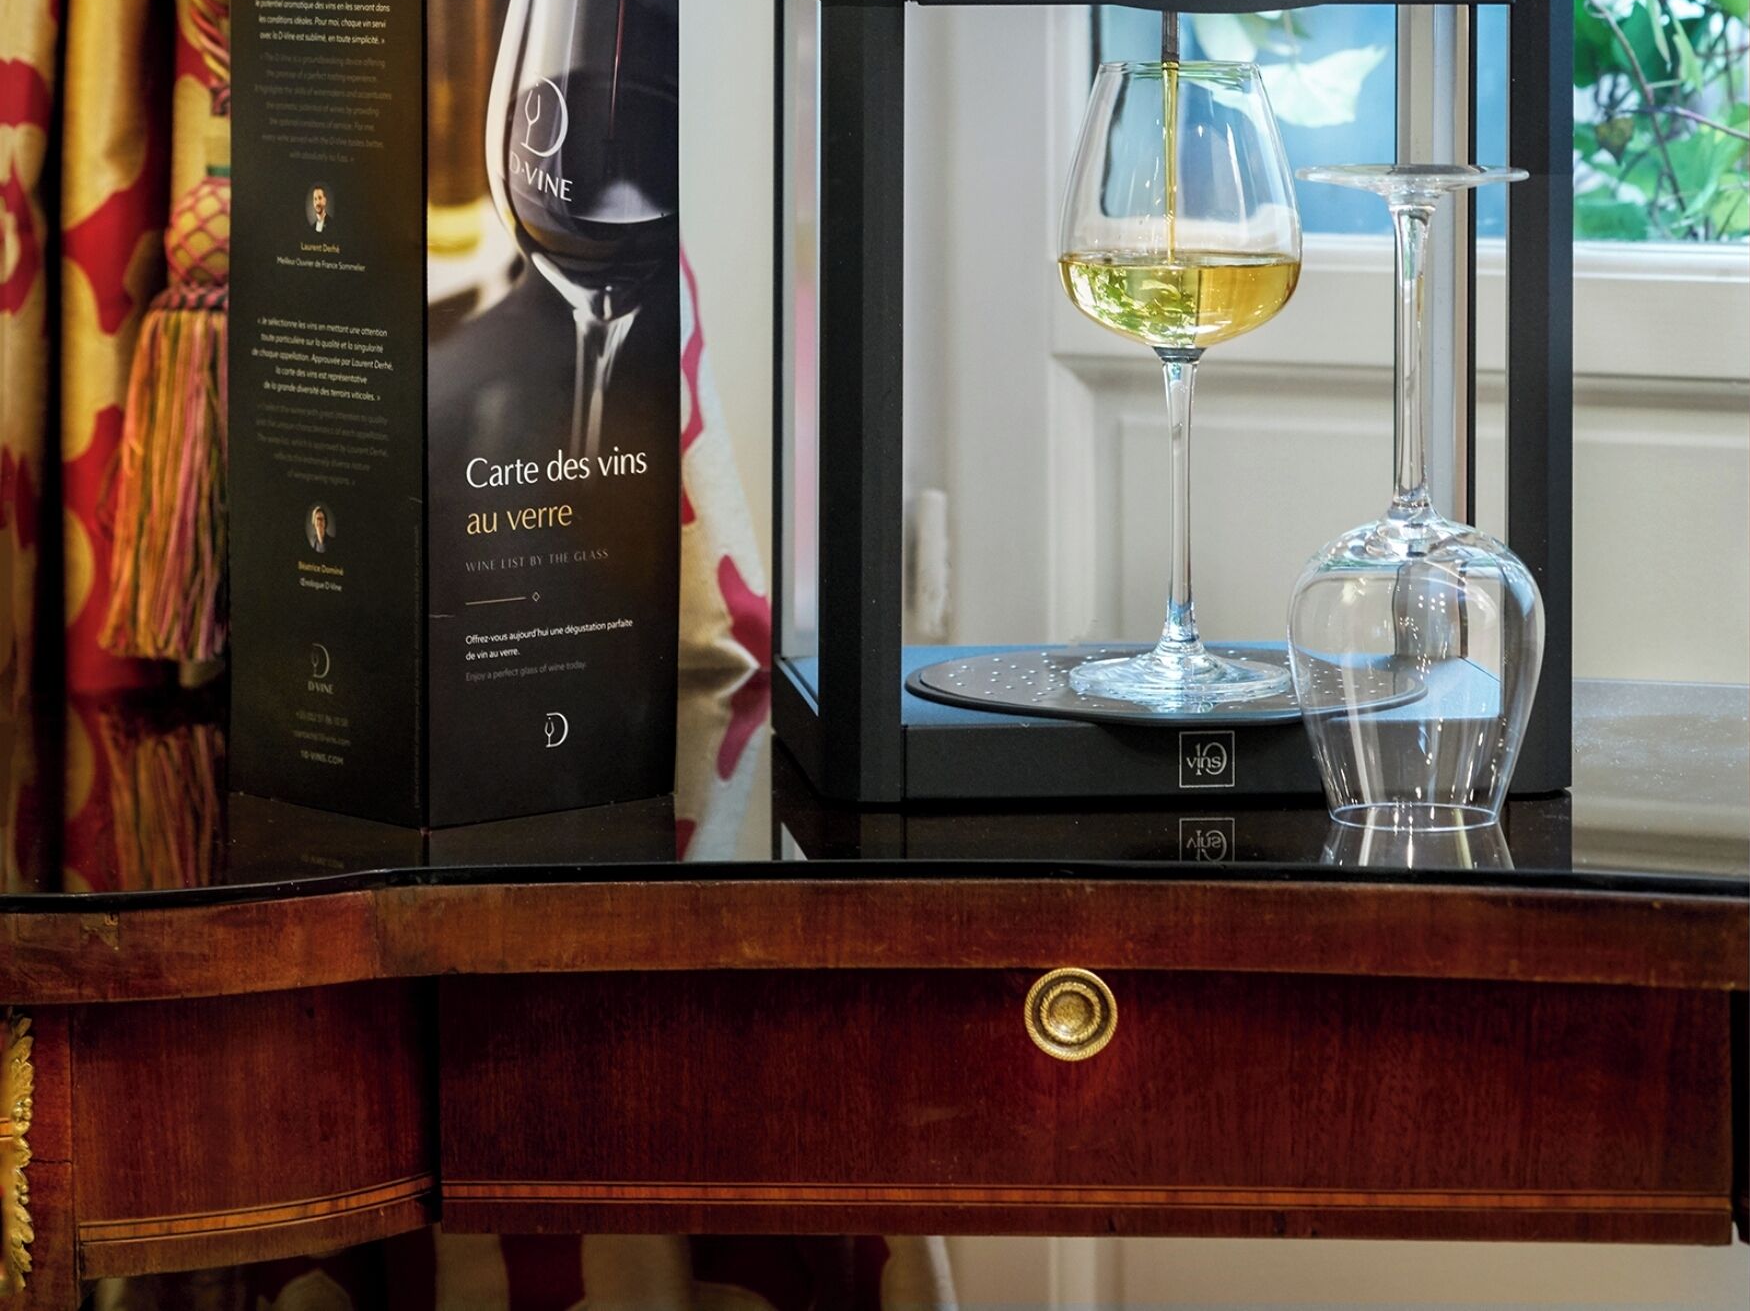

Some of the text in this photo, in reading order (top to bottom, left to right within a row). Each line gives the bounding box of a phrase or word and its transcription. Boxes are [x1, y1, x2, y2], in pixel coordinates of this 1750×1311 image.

[300, 242, 323, 252] Laurent
[466, 446, 648, 488] Carte des vins
[466, 504, 573, 535] au verre
[465, 547, 609, 573] WINE LIST BY THE GLASS
[465, 618, 634, 645] Offrez-vous aujourd'hui une dégustation parfaite
[465, 647, 521, 661] de vin au verre.
[465, 672, 486, 683] Enjoy
[486, 672, 492, 680] a
[492, 666, 519, 681] perfect
[520, 665, 538, 677] glass
[539, 664, 549, 673] of
[548, 662, 566, 672] wine
